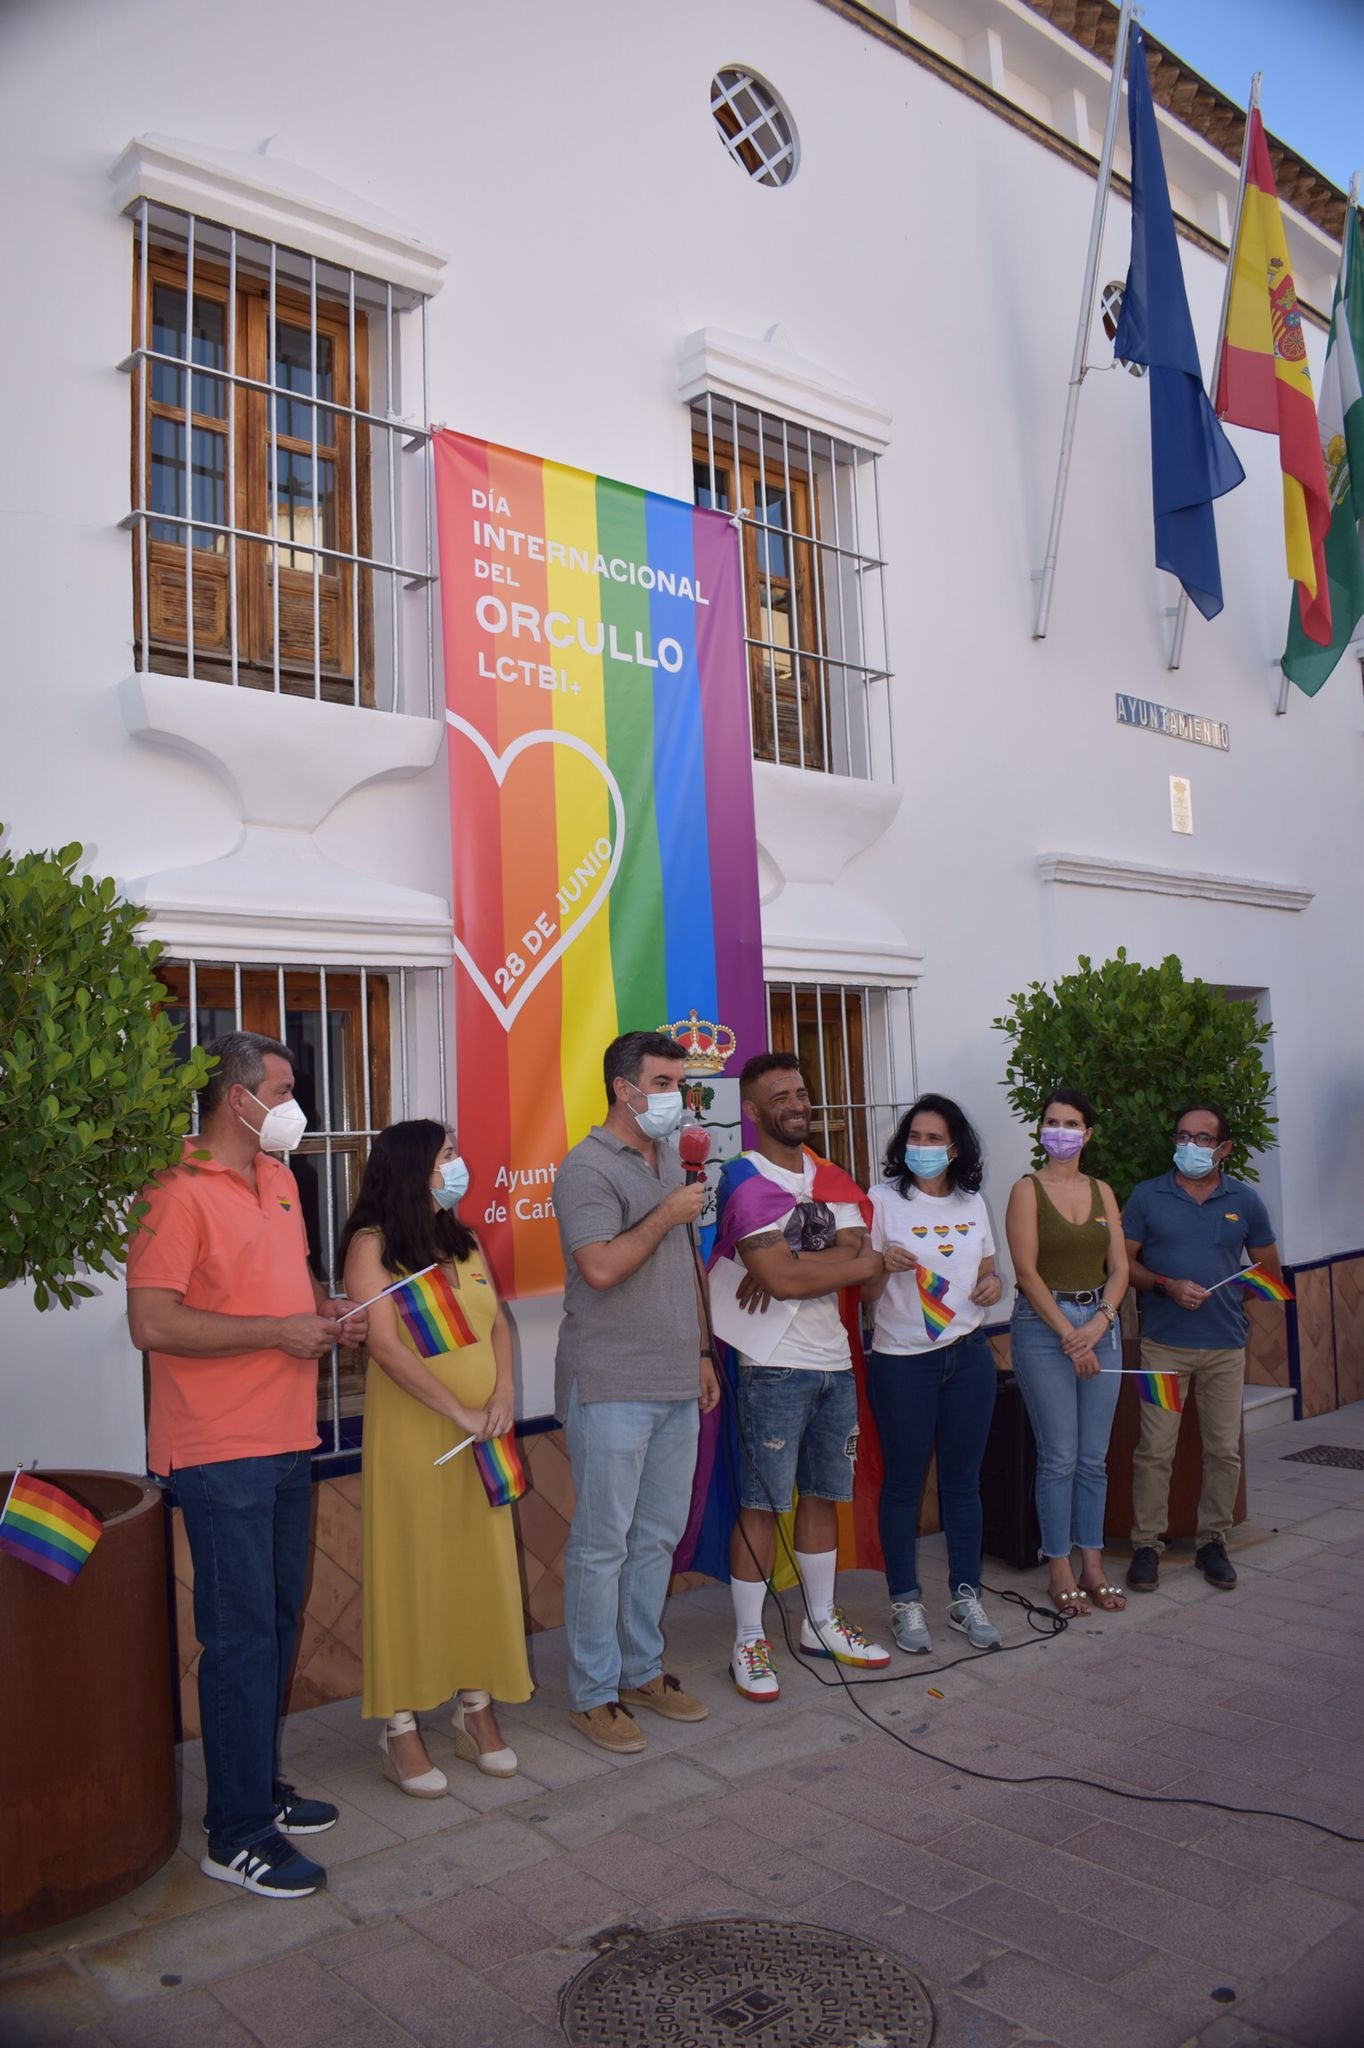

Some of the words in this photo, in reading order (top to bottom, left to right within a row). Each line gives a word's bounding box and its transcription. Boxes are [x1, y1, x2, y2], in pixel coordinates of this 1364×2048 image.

[471, 488, 511, 517] DÍA
[473, 519, 710, 605] INTERNACIONAL
[474, 558, 520, 587] DEL
[1117, 695, 1229, 748] AYUNTAMIENTO
[494, 952, 526, 994] 28
[521, 911, 558, 956] DE
[555, 837, 612, 915] JUNIO
[484, 1200, 507, 1224] de
[680, 1967, 725, 1985] DEL
[734, 1962, 825, 1992] HUESNA
